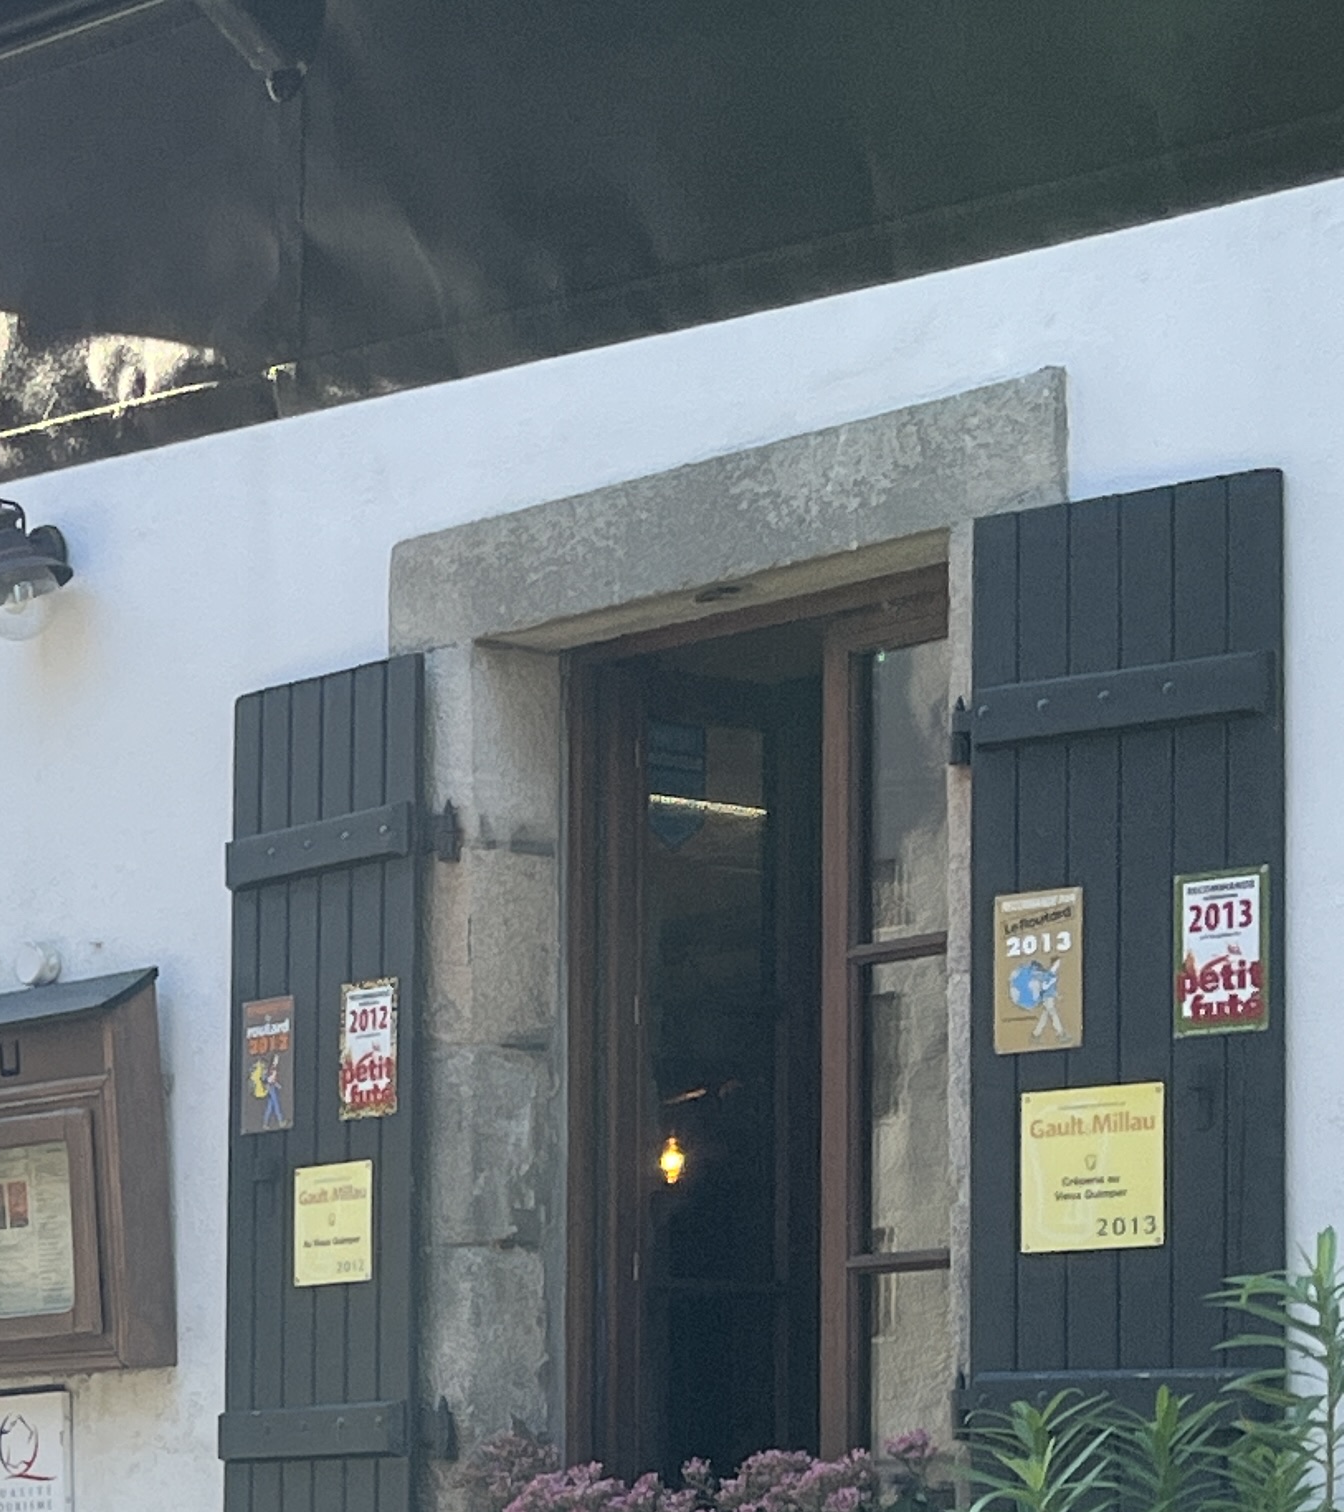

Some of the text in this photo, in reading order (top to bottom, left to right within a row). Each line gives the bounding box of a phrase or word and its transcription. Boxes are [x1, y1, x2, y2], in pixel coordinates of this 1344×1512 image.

[1189, 899, 1254, 933] 2013
[1006, 931, 1072, 957] 2013
[1178, 959, 1263, 1003] petit
[349, 1006, 388, 1033] 2012
[1092, 1111, 1156, 1134] Millau
[1096, 1215, 1157, 1237] 2013
[336, 1260, 366, 1274] 2012
